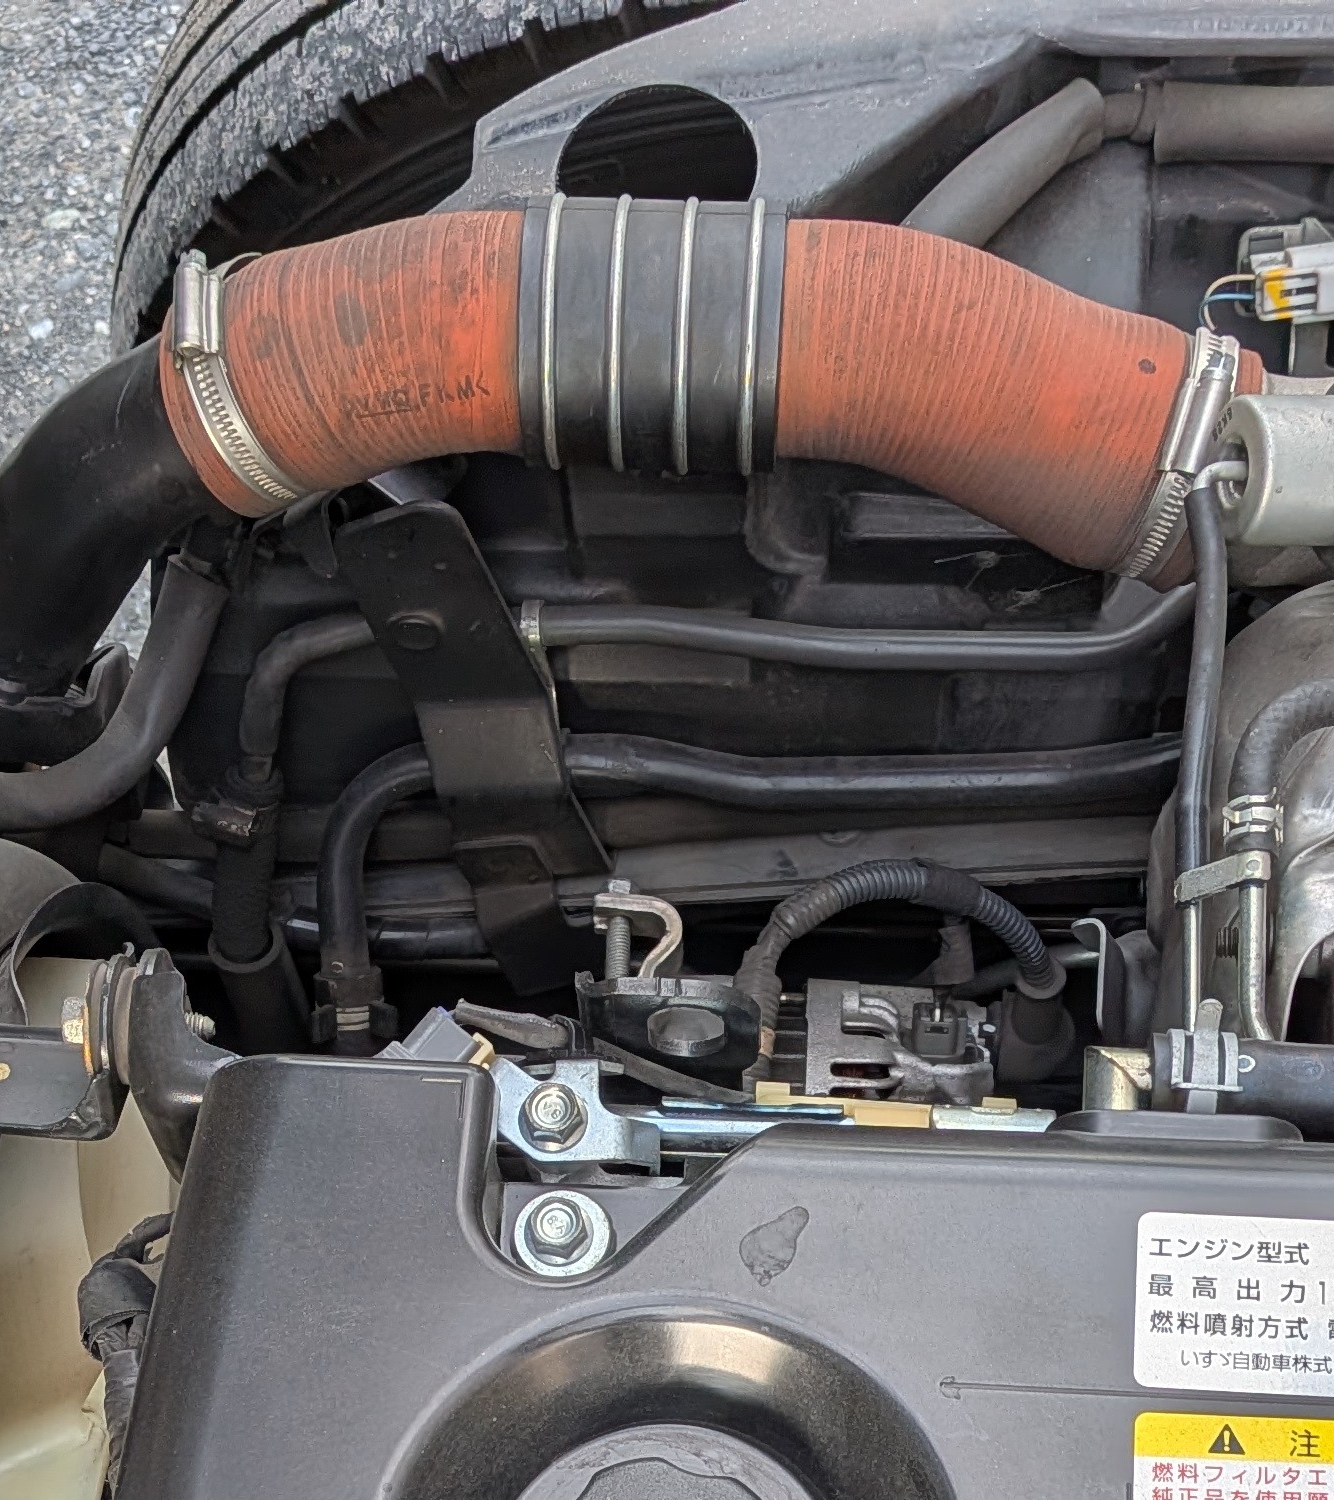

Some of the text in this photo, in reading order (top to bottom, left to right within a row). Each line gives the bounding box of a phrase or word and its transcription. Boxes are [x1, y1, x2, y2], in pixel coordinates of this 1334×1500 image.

[1148, 1237, 1310, 1267] エンジン型式
[1147, 1273, 1306, 1304] 最高出力
[1149, 1310, 1308, 1341] 燃料噴射方式
